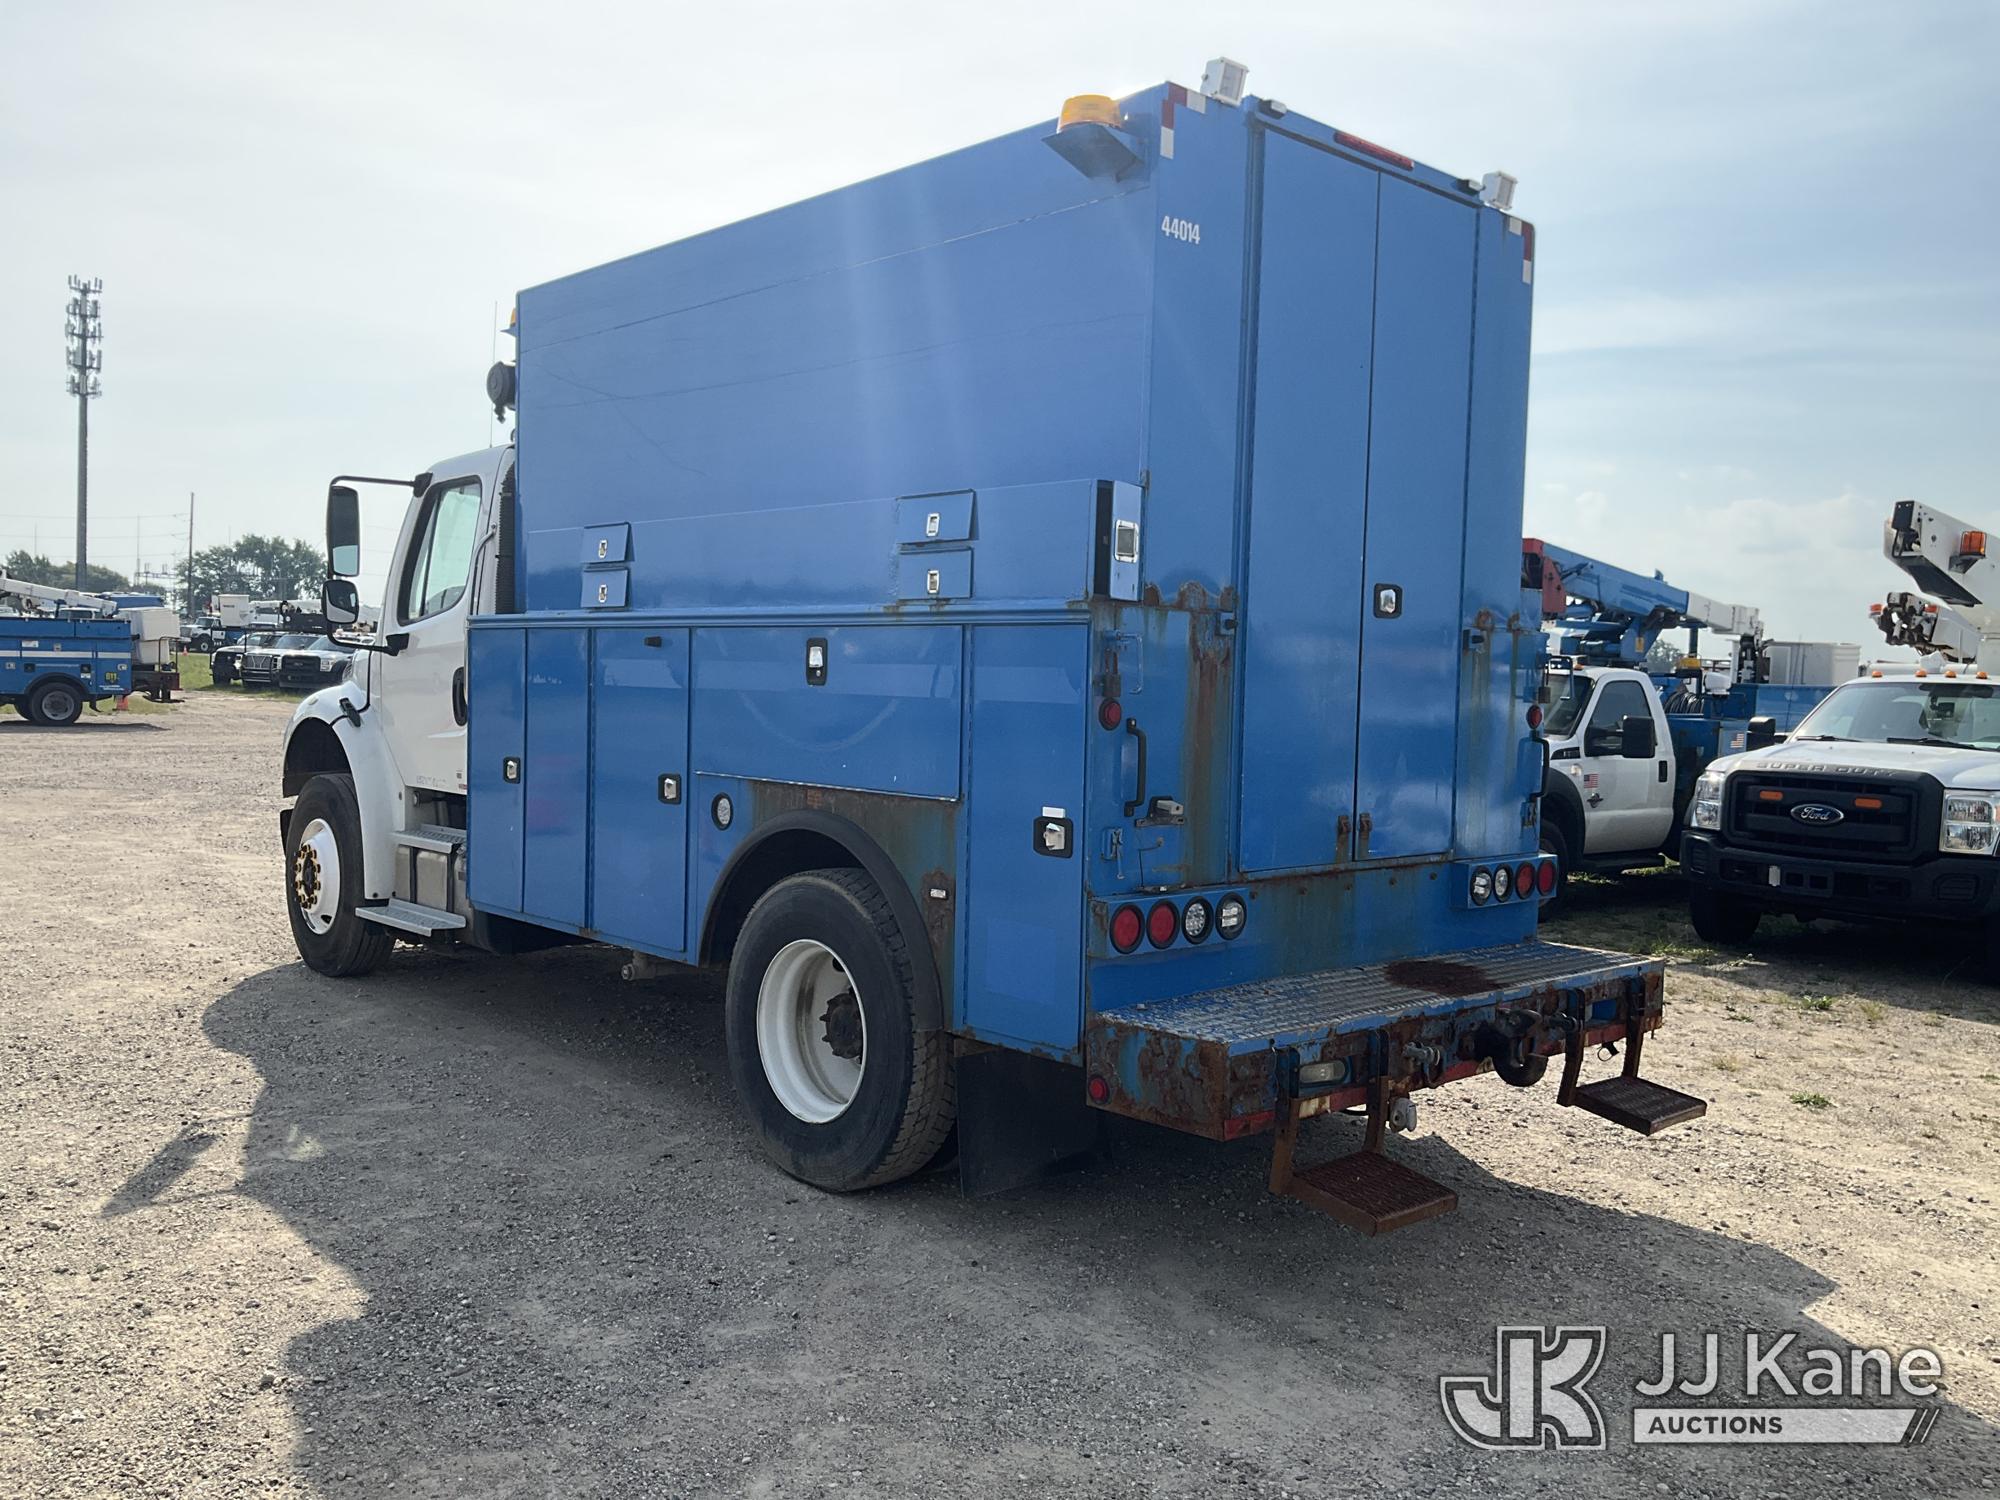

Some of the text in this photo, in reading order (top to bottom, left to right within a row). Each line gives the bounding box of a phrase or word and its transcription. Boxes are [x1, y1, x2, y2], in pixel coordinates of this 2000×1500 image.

[1161, 215, 1200, 245] 44014
[1757, 761, 1826, 772] SUPER
[1800, 806, 1832, 821] Ford
